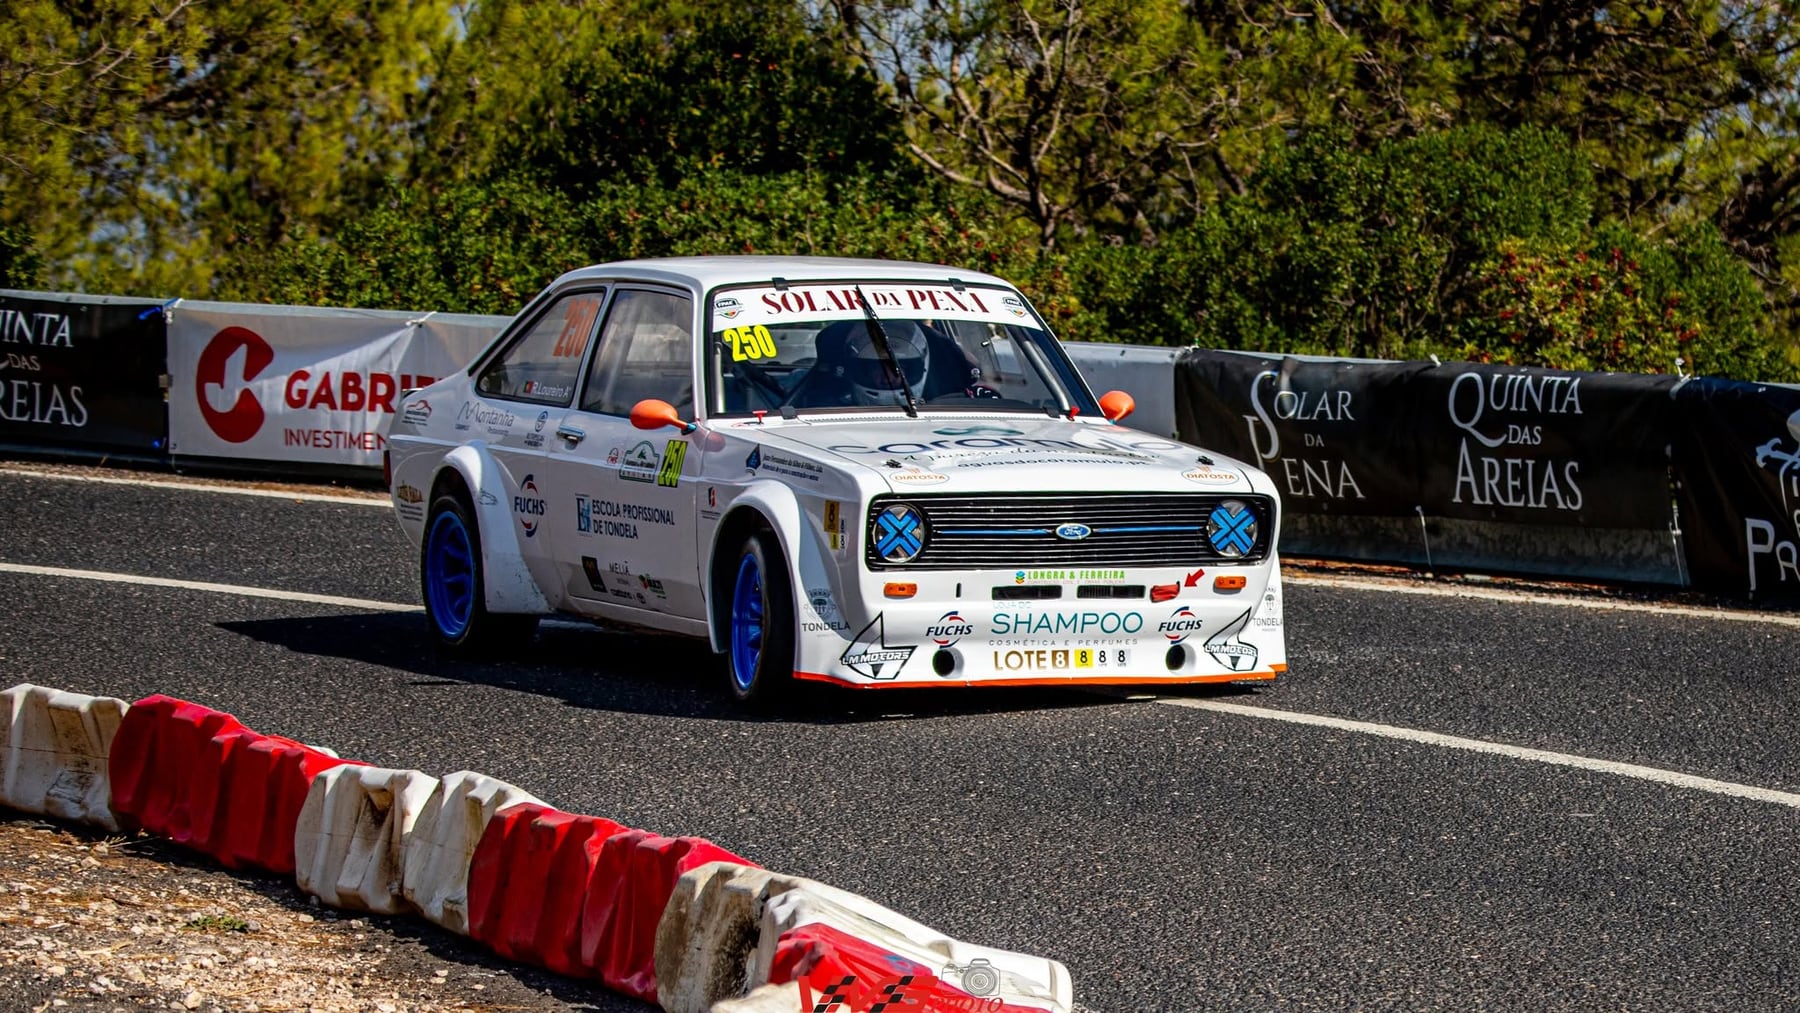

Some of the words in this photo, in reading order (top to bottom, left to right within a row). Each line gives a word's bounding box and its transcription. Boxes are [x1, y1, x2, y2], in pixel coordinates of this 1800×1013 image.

[762, 290, 865, 314] SOLAR
[873, 293, 902, 306] DA
[906, 290, 990, 313] PENA
[0, 310, 74, 347] INTA
[553, 298, 599, 357] 250
[723, 324, 777, 362] 250
[8, 353, 41, 371] DAS
[285, 370, 442, 413] GABR
[457, 400, 515, 427] Montanha
[1251, 370, 1355, 459] SOLAR
[1449, 372, 1584, 447] QUINTA
[827, 437, 1184, 454] caramulo
[1304, 433, 1325, 447] DA
[1507, 425, 1542, 445] DAS
[658, 440, 687, 487] 250
[1452, 437, 1583, 511] AREIAS
[514, 496, 545, 516] FUCHS
[592, 499, 621, 517] ESCOLA
[623, 504, 675, 526] PROFISSIONAL
[593, 519, 603, 534] DE
[604, 520, 638, 539] TONDELA
[1028, 570, 1065, 580] LONGRA
[1069, 570, 1076, 579] &
[1079, 570, 1125, 579] FERREIRA
[802, 621, 851, 632] TONDELA
[925, 624, 973, 636] FUCHS
[991, 611, 1143, 634] SHAMPOO
[1158, 619, 1203, 632] FUCHS
[988, 638, 1056, 646] COSMÉTICA
[1078, 638, 1138, 646] PERFUMES
[994, 650, 1047, 670] LOTE
[1055, 651, 1066, 668] 8
[1080, 651, 1088, 663] 8
[1099, 650, 1106, 663] 8
[1118, 650, 1125, 663] 8
